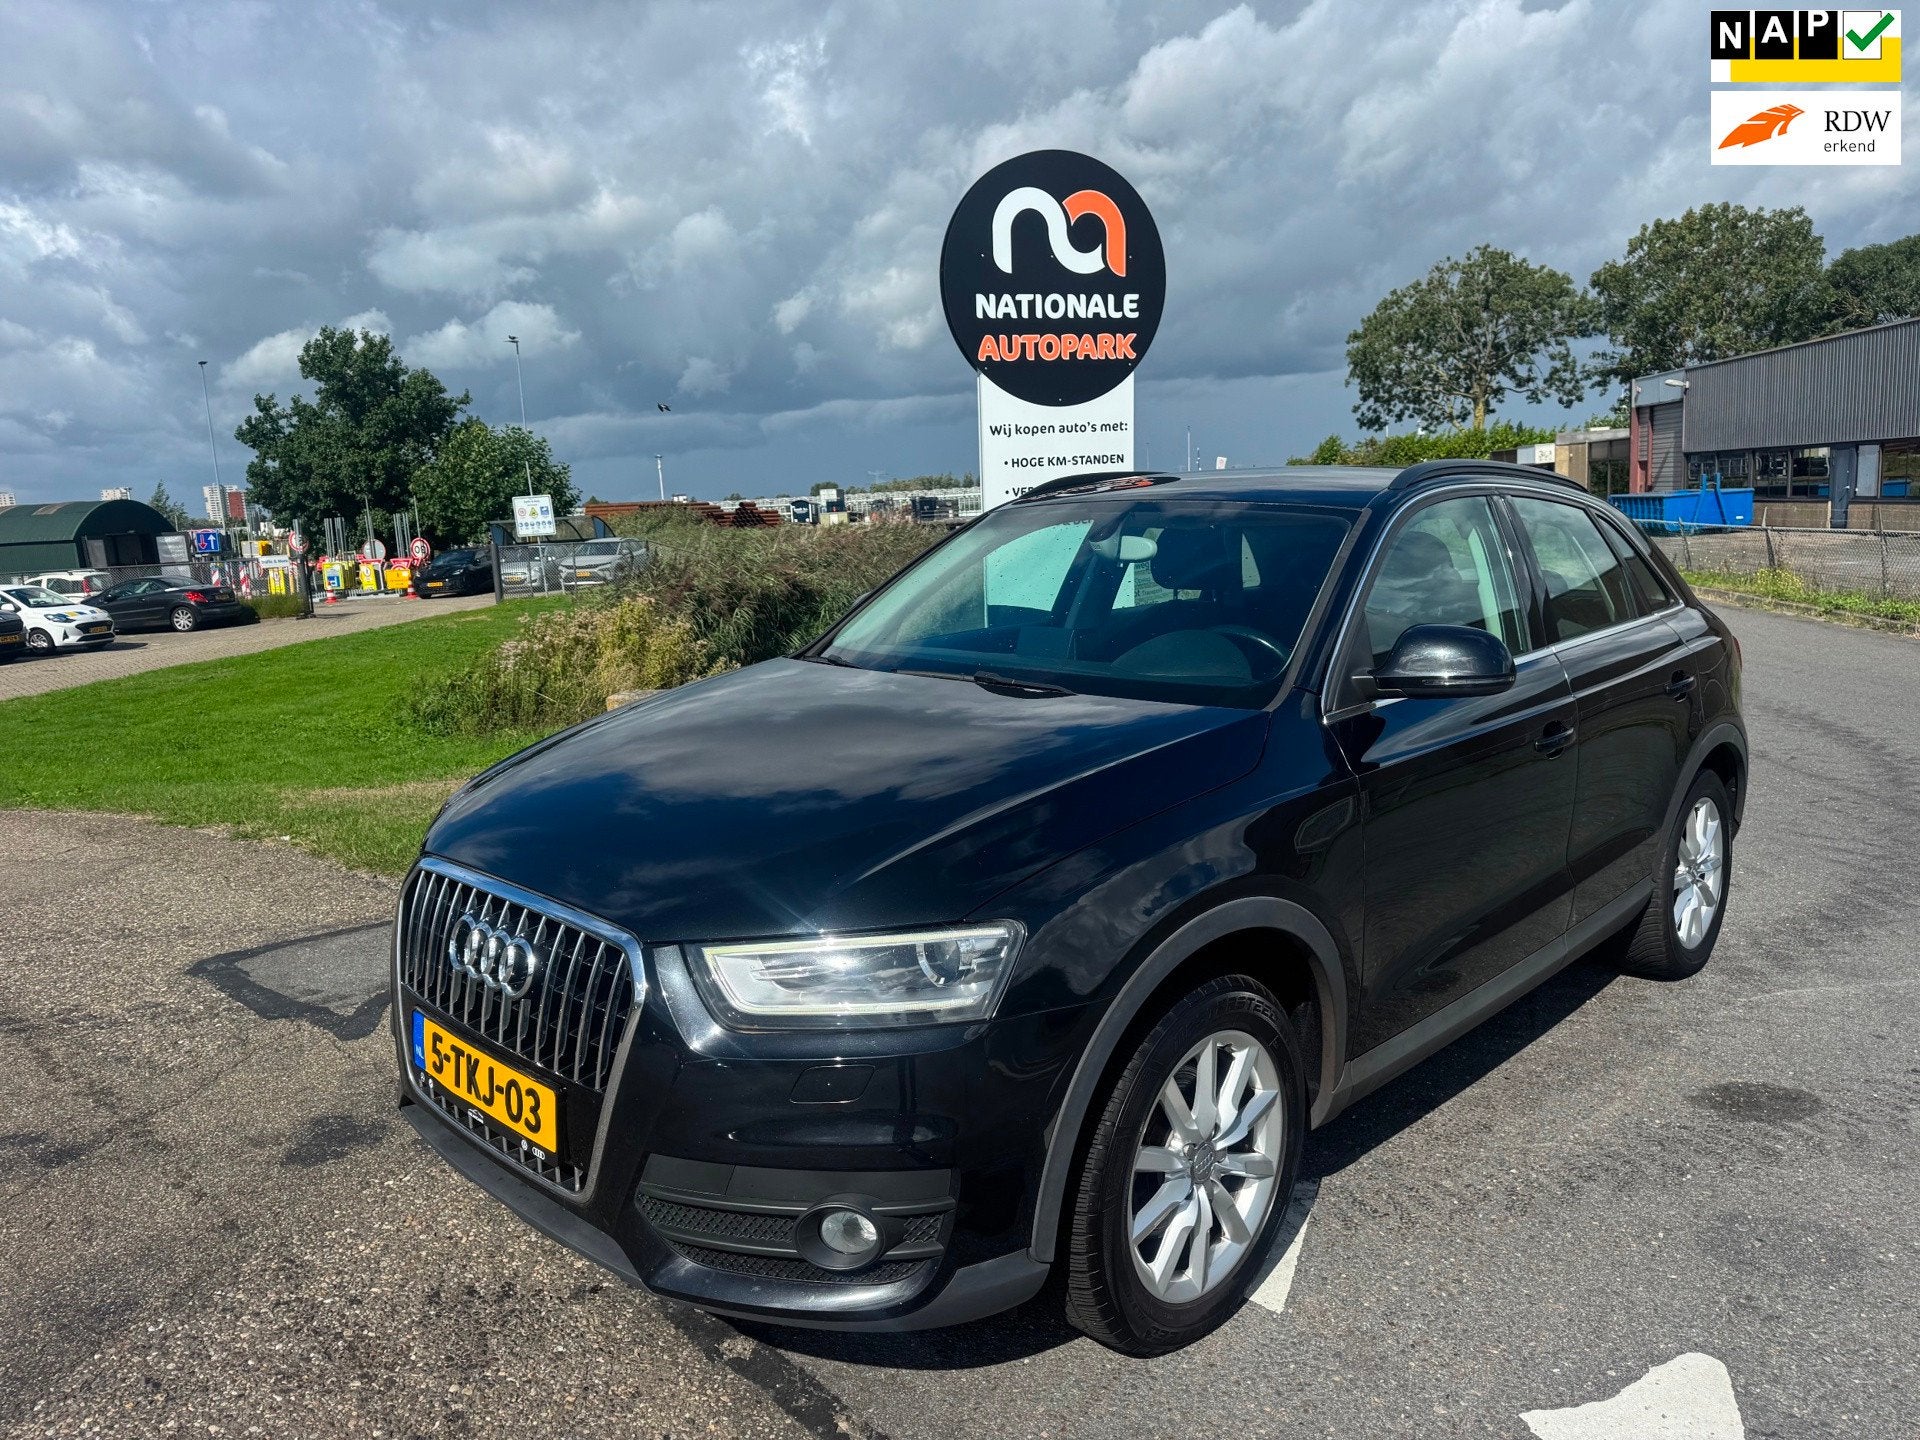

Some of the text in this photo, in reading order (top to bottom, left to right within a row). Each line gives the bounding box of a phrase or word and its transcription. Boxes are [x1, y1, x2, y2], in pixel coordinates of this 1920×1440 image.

[975, 293, 1140, 319] NATIONALE
[977, 333, 1137, 361] AUTOPARK
[989, 421, 1128, 438] Wij kopen auto's met:
[1011, 454, 1125, 468] HOGE KM-STANDEN
[432, 1031, 542, 1134] 5-TKJ-03
